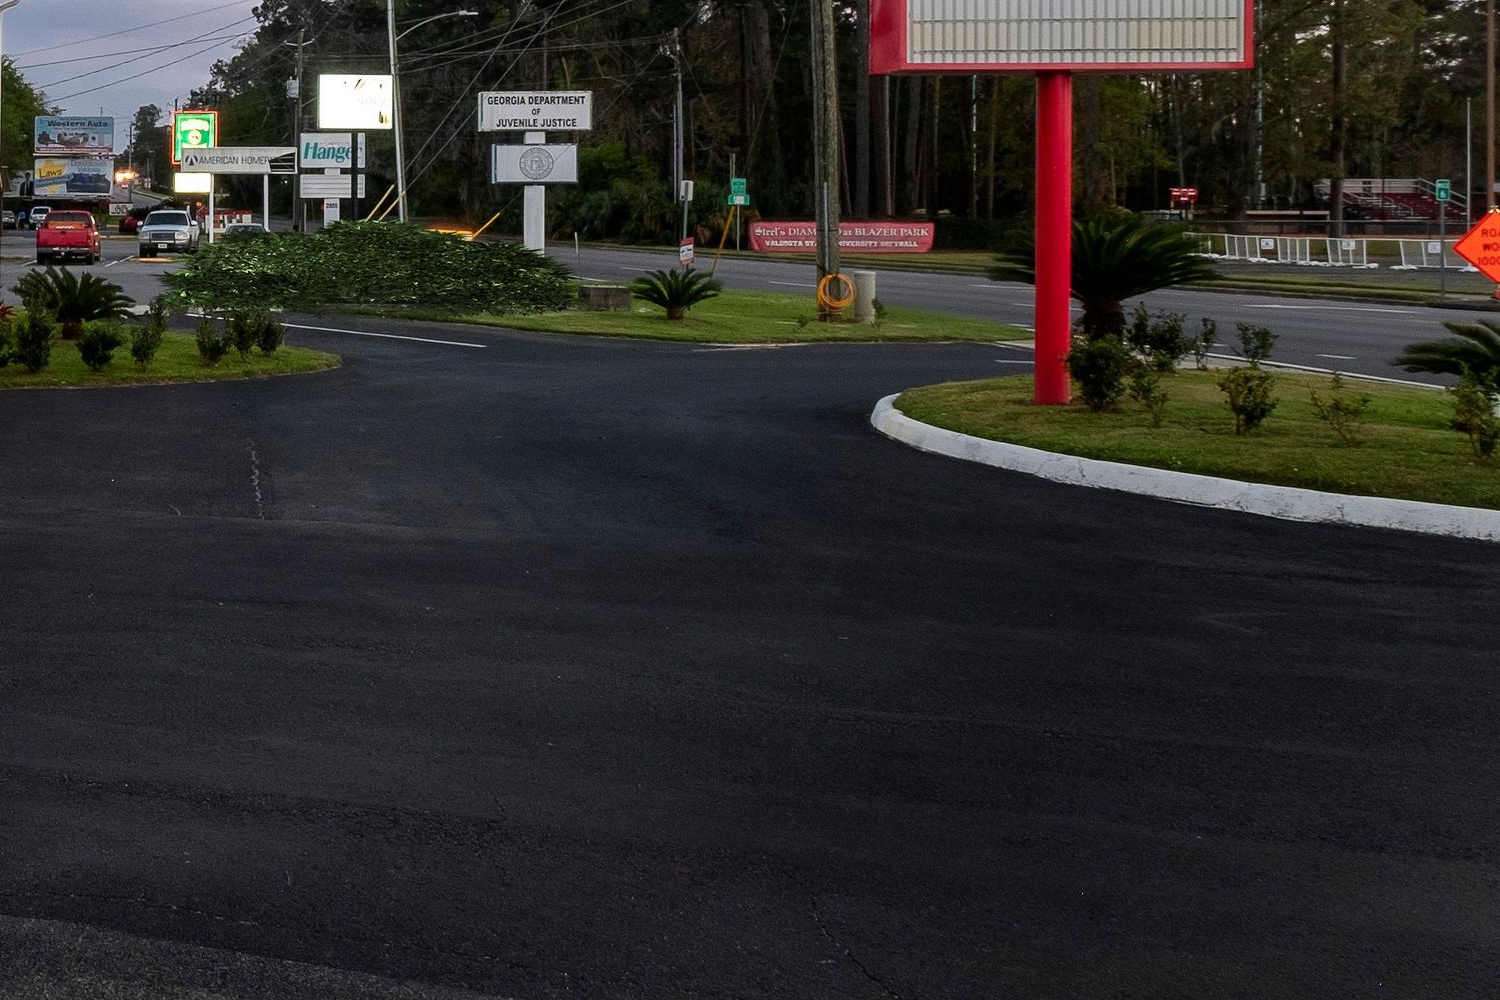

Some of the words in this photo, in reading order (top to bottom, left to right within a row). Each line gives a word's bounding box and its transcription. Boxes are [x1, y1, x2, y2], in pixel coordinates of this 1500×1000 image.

[487, 96, 526, 105] GEORGIA
[528, 96, 586, 105] DEPARTMENT
[531, 108, 541, 116] OF
[496, 118, 538, 128] JUVENILE
[540, 118, 577, 128] JUSTICE
[198, 156, 239, 165] AMERICAN
[39, 168, 63, 178] Laws
[854, 227, 897, 236] BLAZER
[900, 227, 929, 236] PARK
